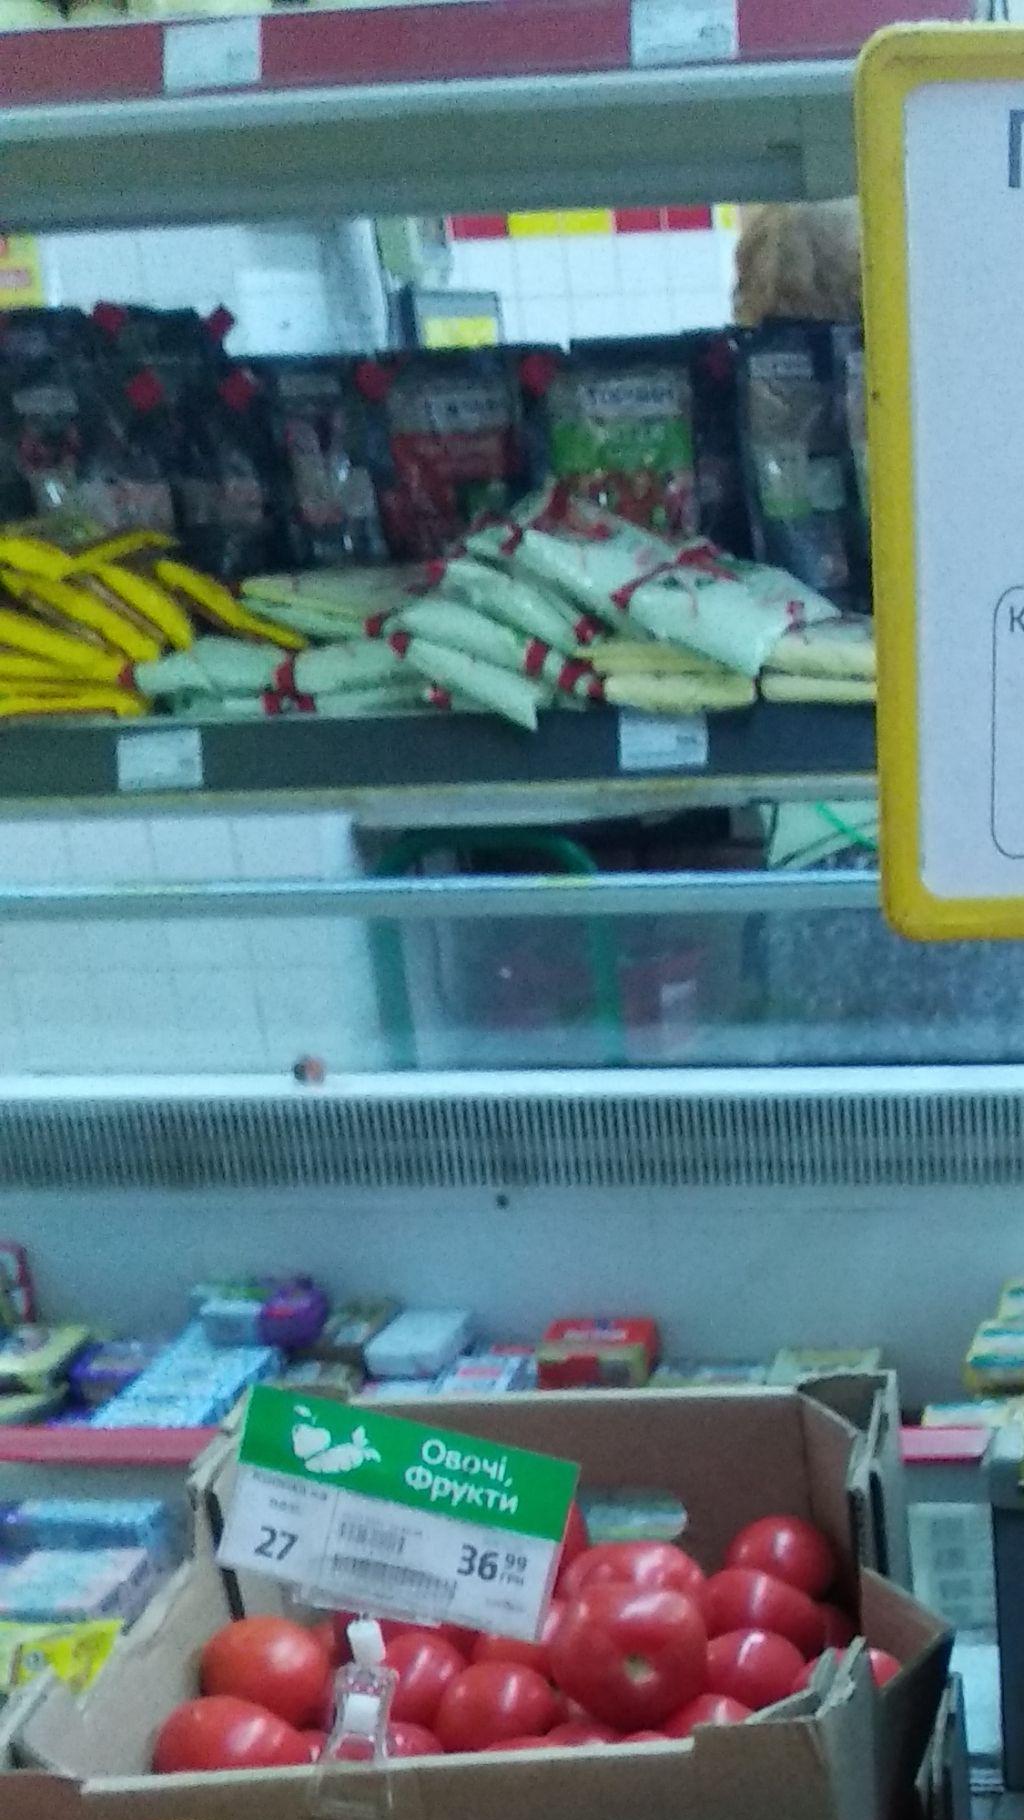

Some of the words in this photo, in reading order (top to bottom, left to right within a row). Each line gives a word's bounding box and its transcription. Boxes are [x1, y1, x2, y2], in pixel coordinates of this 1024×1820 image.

[420, 1438, 513, 1488] Овочі,
[254, 1525, 299, 1561] 27
[456, 1543, 500, 1583] 36
[503, 1552, 528, 1573] 99
